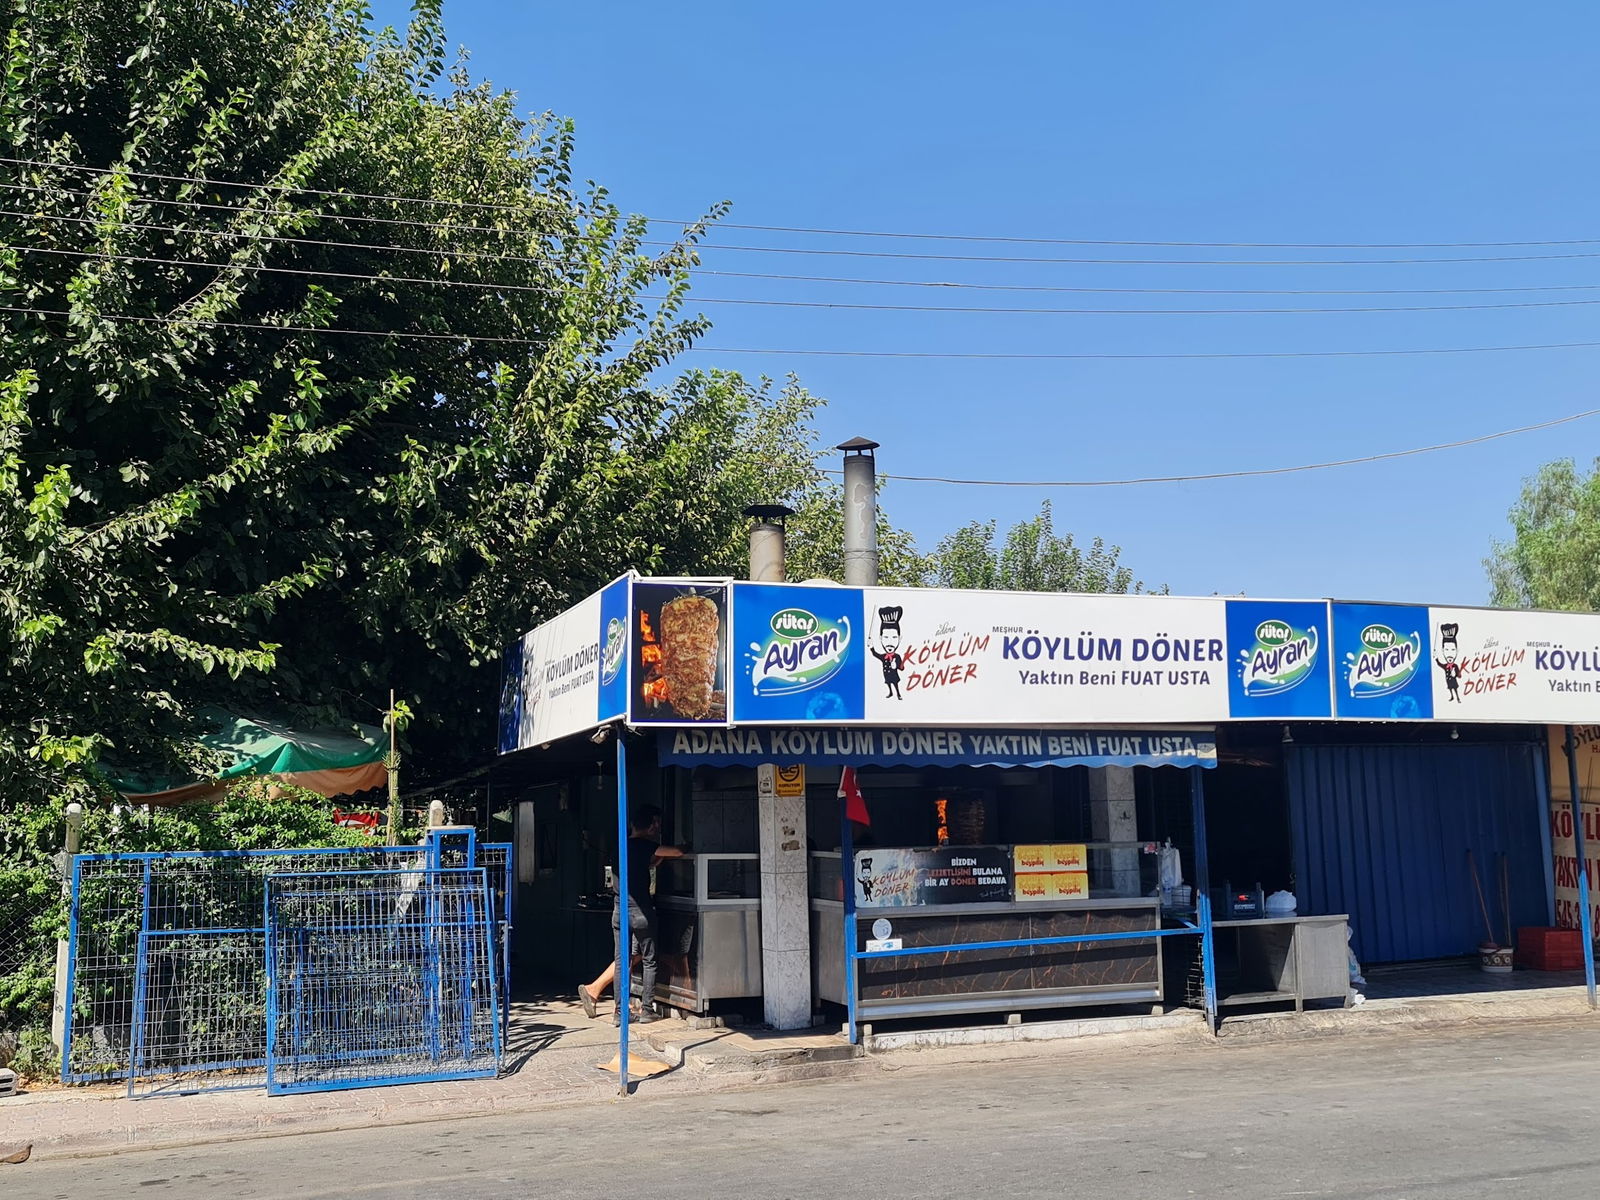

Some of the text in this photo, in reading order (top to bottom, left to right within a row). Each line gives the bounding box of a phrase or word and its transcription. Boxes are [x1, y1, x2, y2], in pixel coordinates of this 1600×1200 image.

[775, 613, 814, 634] sütaş
[992, 626, 1023, 635] MEŞHUR
[1259, 625, 1290, 642] sütaş
[1003, 630, 1224, 662] KÖYLÜM DÖNER
[1364, 629, 1393, 646] sütaş
[1526, 641, 1551, 649] MEŞHUR
[574, 643, 598, 671] DÖNER
[763, 631, 837, 675] Ayran
[902, 632, 990, 666] KÖYLÜM
[1252, 639, 1308, 678] Ayran
[1460, 646, 1526, 674] KÖYLÜM
[1357, 643, 1412, 680] Ayran
[905, 663, 978, 691] DÖNER
[1019, 670, 1210, 686] Yaktın Beni FUAT USTA
[1463, 672, 1518, 696] DÖNER
[1549, 679, 1591, 693] Yaktın
[672, 730, 764, 755] ADANA
[771, 726, 875, 756] KÖYLÜM
[882, 728, 965, 756] DÖNER
[969, 735, 1042, 756] YAKTIN
[1047, 732, 1093, 756] BENİ
[1096, 737, 1142, 756] FUAT
[1148, 737, 1197, 756] USTA
[951, 857, 977, 867] BİZDEN
[972, 867, 1003, 876] BULANA
[924, 878, 937, 887] BİR
[939, 878, 949, 886] AY
[978, 877, 1007, 886] BEDAVA
